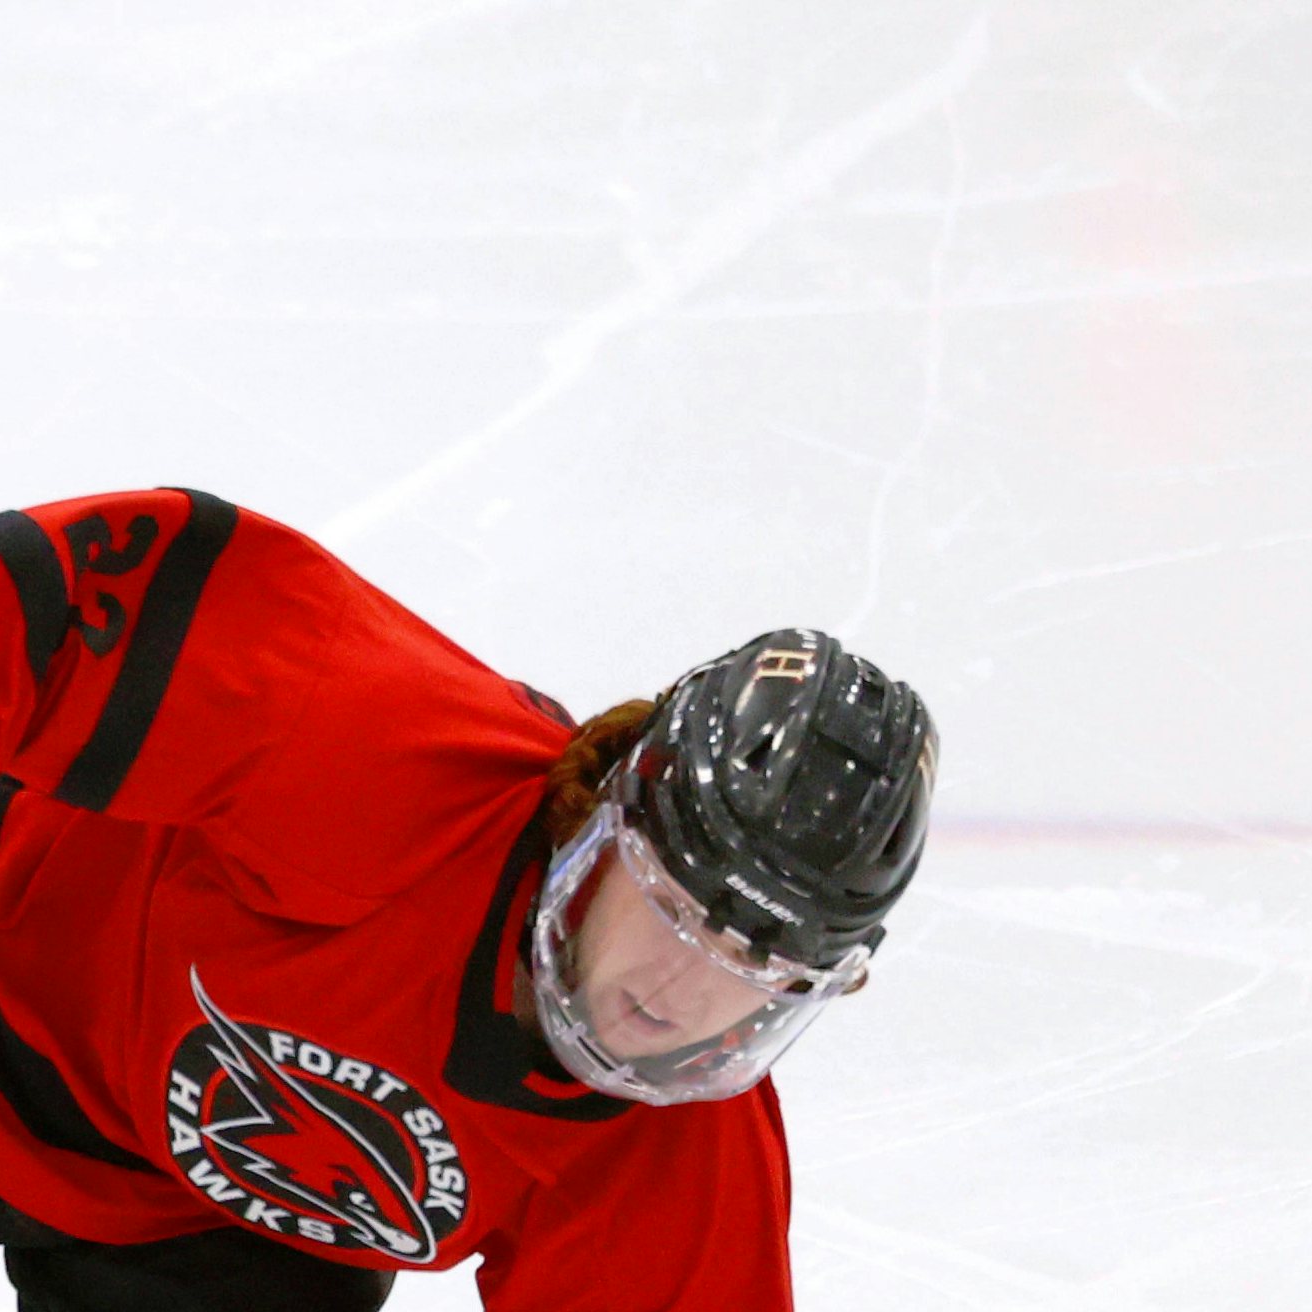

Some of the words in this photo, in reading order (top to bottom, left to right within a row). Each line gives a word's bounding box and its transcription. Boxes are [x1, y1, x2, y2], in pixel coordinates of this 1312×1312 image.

[167, 1068, 337, 1245] HAWKS
[268, 1031, 409, 1101] FORT
[402, 1106, 466, 1221] SASK
